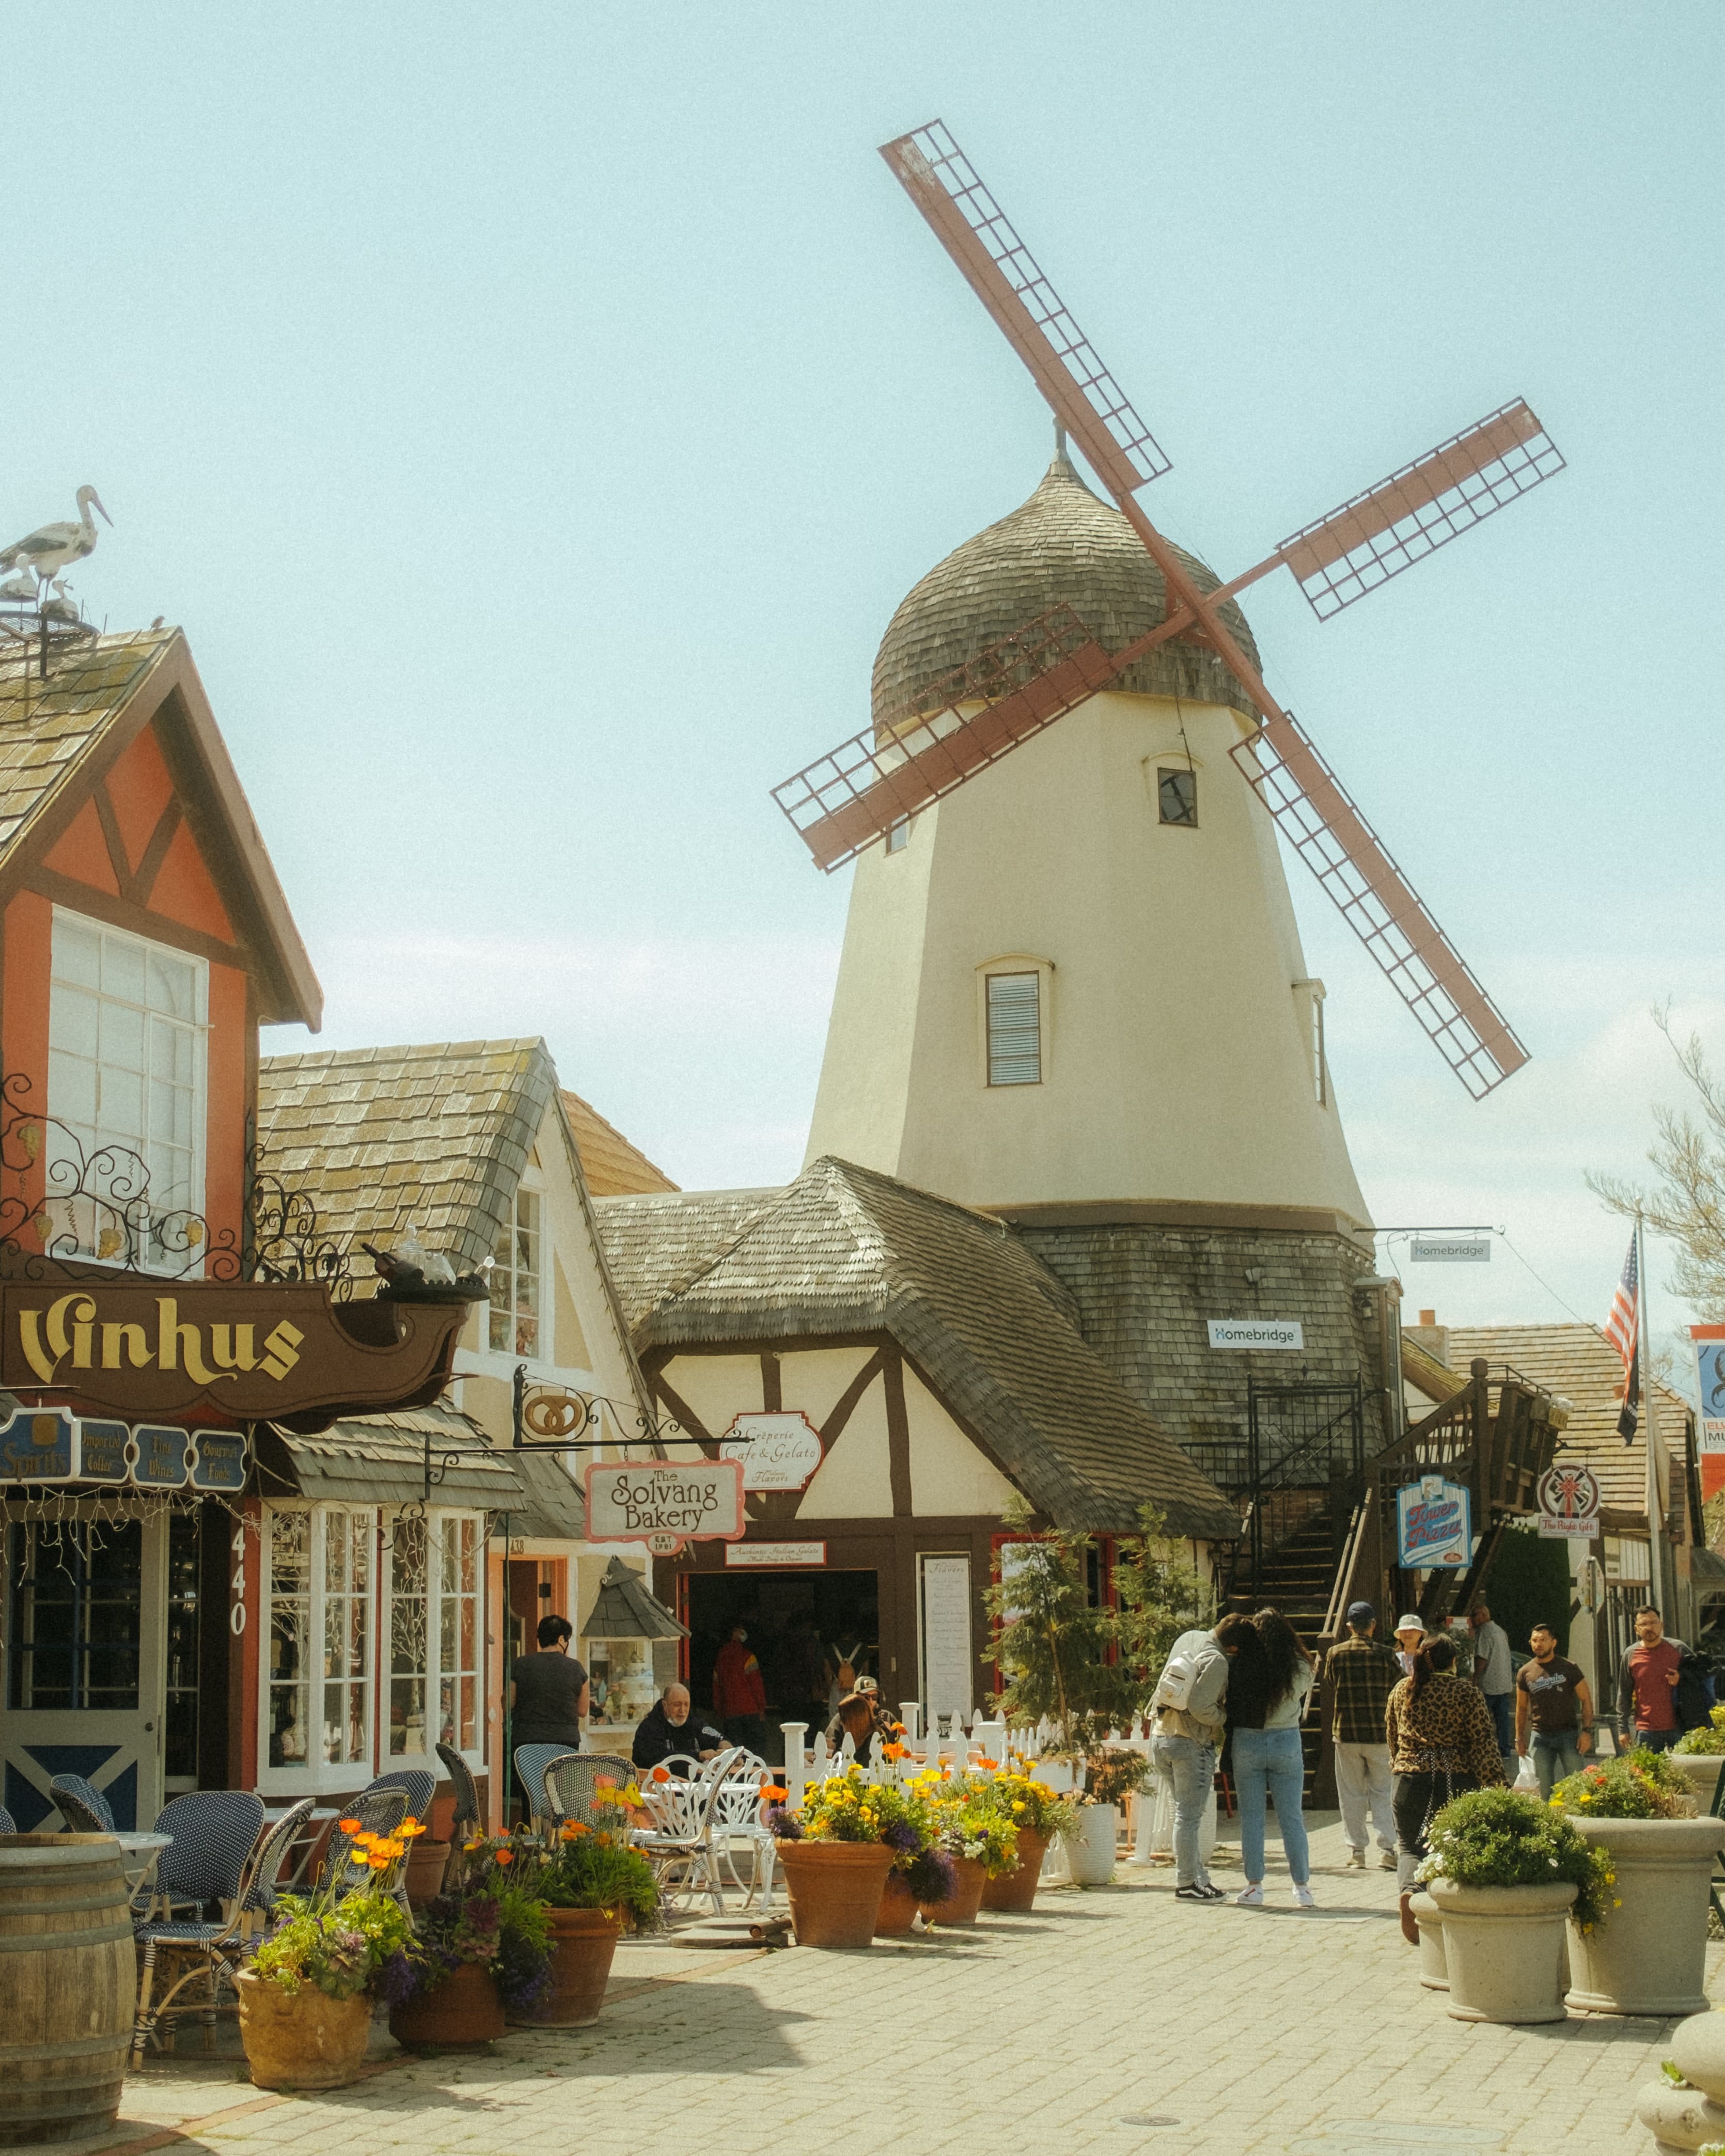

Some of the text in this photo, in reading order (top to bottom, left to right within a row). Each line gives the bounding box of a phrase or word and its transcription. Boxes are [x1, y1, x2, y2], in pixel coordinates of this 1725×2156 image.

[1415, 1245, 1484, 1256] Homebridge
[19, 1293, 305, 1385] Vinhus
[1215, 1328, 1294, 1343] Homebridge
[746, 1427, 794, 1444] Crêperie
[760, 1446, 769, 1458] &
[770, 1441, 816, 1462] Gelato
[149, 1457, 174, 1478] Wines
[208, 1462, 231, 1481] Foods
[654, 1470, 678, 1482] The
[611, 1475, 718, 1511] Solvang
[625, 1505, 704, 1532] Bakery
[1409, 1503, 1457, 1526] Tower
[1542, 1520, 1556, 1529] The
[1407, 1520, 1462, 1548] Pizza
[510, 1539, 524, 1554] 438
